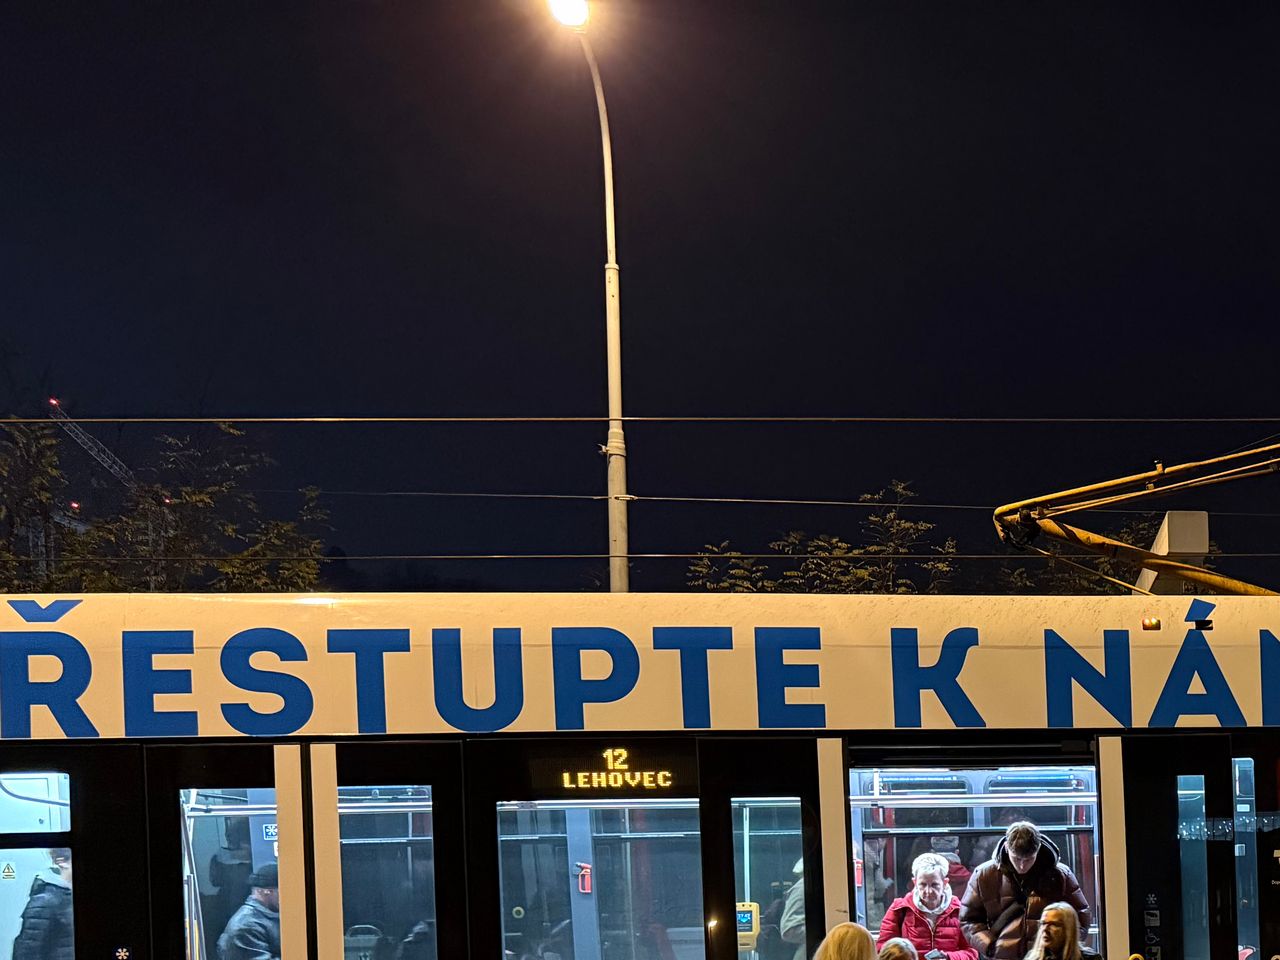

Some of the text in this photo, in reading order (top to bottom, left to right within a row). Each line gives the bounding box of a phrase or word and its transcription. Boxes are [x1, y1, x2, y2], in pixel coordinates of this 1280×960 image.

[891, 628, 986, 728] K
[603, 749, 629, 770] 12
[563, 771, 672, 788] LEHOVEC
